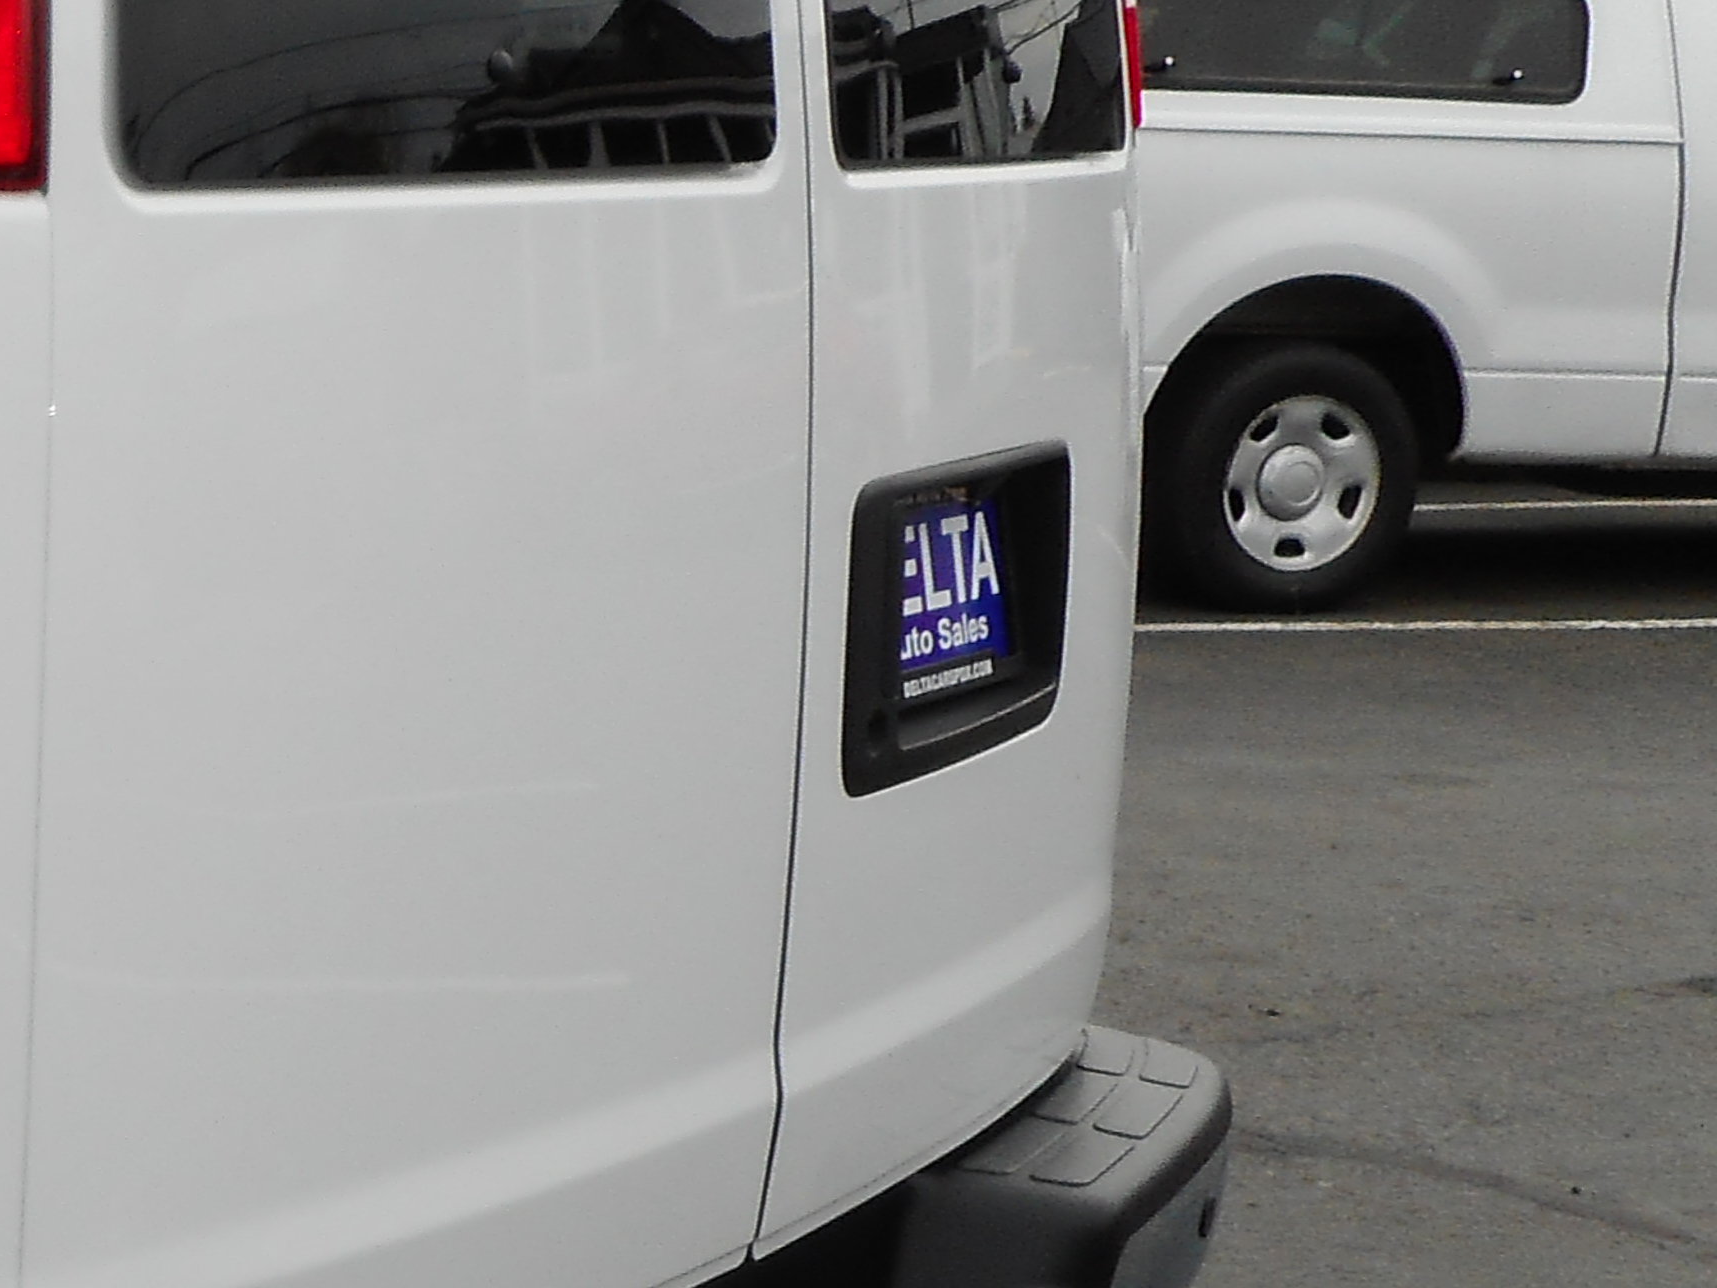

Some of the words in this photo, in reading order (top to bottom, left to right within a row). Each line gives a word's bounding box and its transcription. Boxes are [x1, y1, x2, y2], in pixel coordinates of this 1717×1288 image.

[903, 511, 1000, 617] ELTA
[900, 626, 934, 661] uto
[937, 613, 989, 650] Sales
